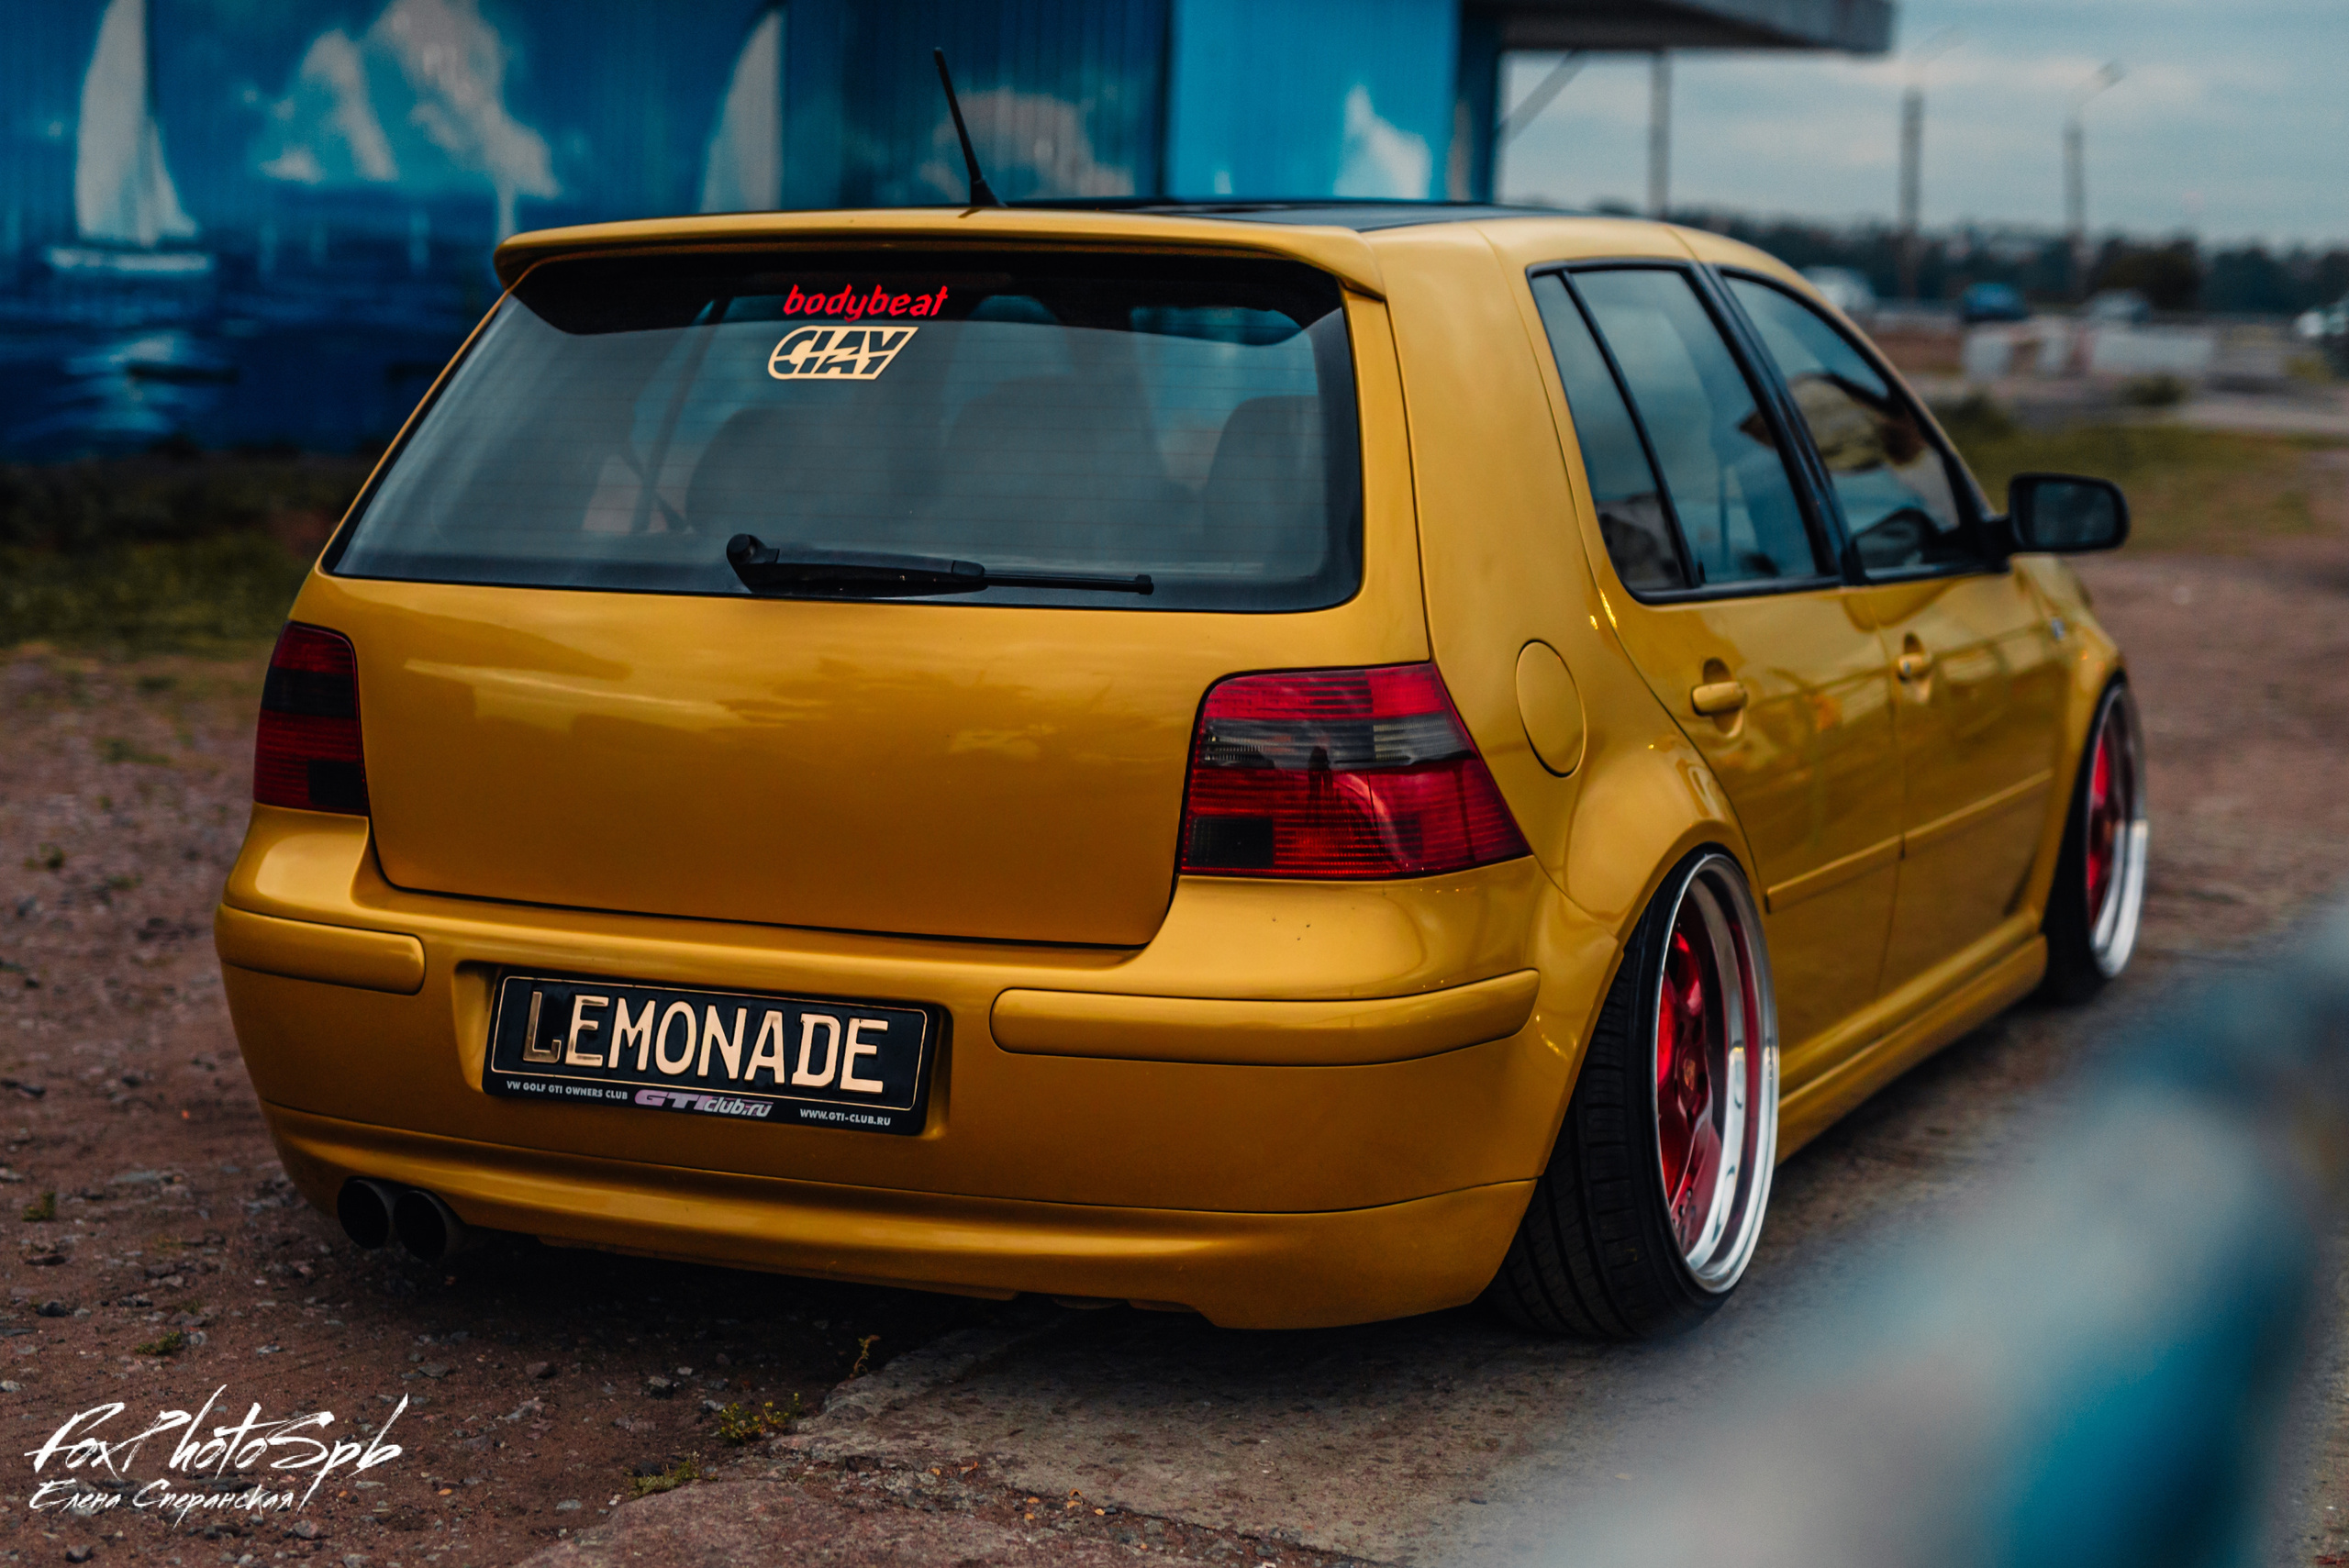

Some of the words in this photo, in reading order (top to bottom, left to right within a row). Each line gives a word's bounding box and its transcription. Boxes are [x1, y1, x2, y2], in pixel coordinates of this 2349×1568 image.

[783, 284, 948, 323] bodybeat
[523, 991, 889, 1093] LEMONADE
[507, 1080, 520, 1090] VW
[523, 1082, 546, 1092] GOLF
[548, 1084, 562, 1094] GTI
[565, 1086, 603, 1097] OWNERS
[606, 1090, 628, 1100] CLUB
[799, 1108, 891, 1126] WWW.GTI-CLUB.RU
